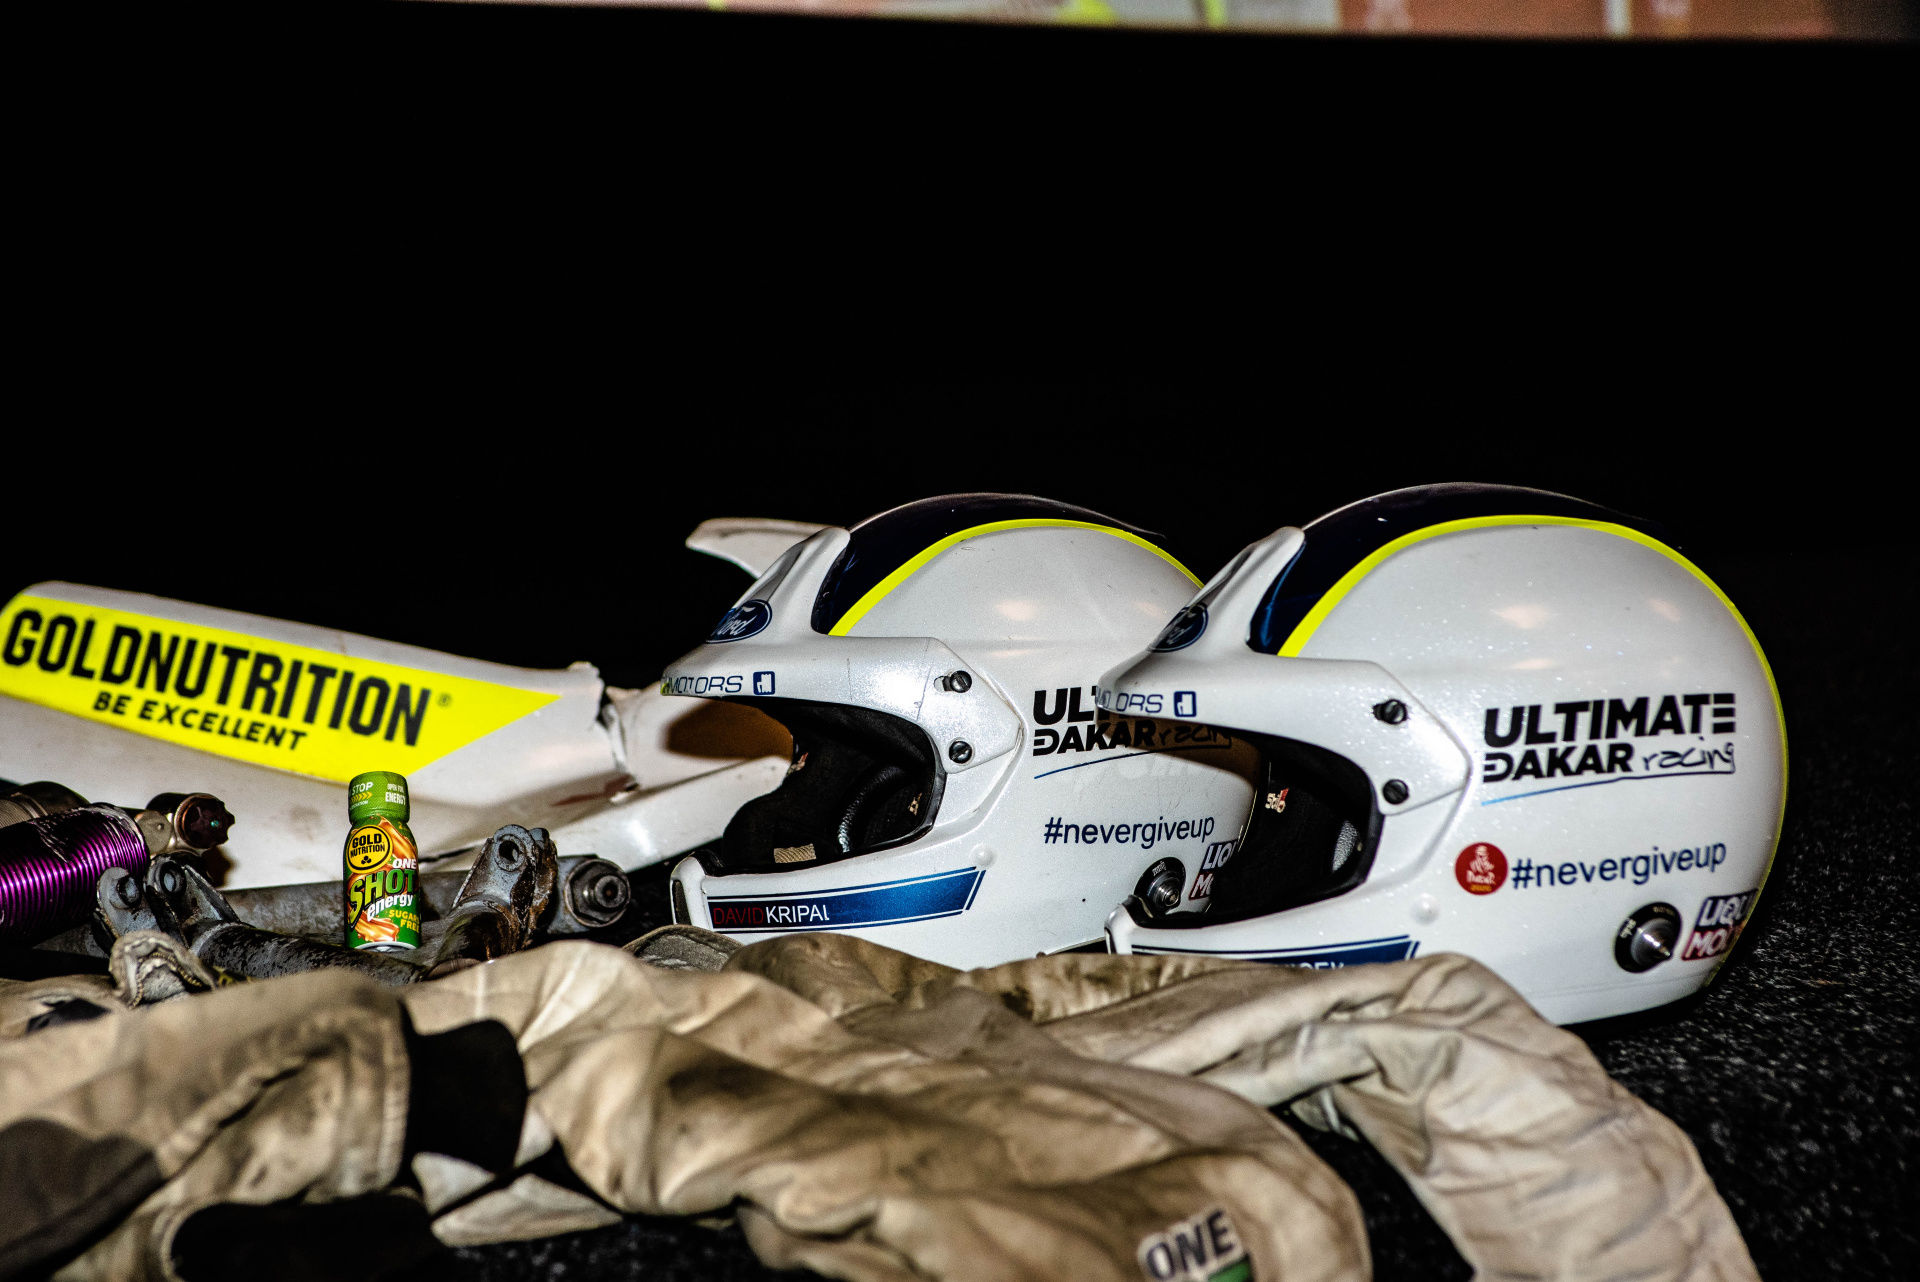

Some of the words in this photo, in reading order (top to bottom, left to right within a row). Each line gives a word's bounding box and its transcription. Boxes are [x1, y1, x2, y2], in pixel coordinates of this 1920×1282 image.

[2, 608, 432, 748] GOLDNUTRITION
[93, 691, 131, 716] BE
[137, 699, 307, 750] EXCELLENT
[1033, 720, 1156, 756] DAKAR
[1484, 693, 1736, 748] ULTIMATE
[1483, 743, 1634, 783] DAKAR
[1641, 736, 1736, 775] racing
[351, 781, 374, 796] STOP
[350, 843, 386, 858] NUTRITION
[352, 833, 382, 848] GOLD
[1044, 816, 1215, 849] #nevergiveup
[392, 858, 417, 869] ONE
[1512, 843, 1727, 889] #nevergiveup
[349, 868, 417, 925] SHOT
[366, 894, 414, 922] energy
[1147, 1210, 1234, 1281] ONE
